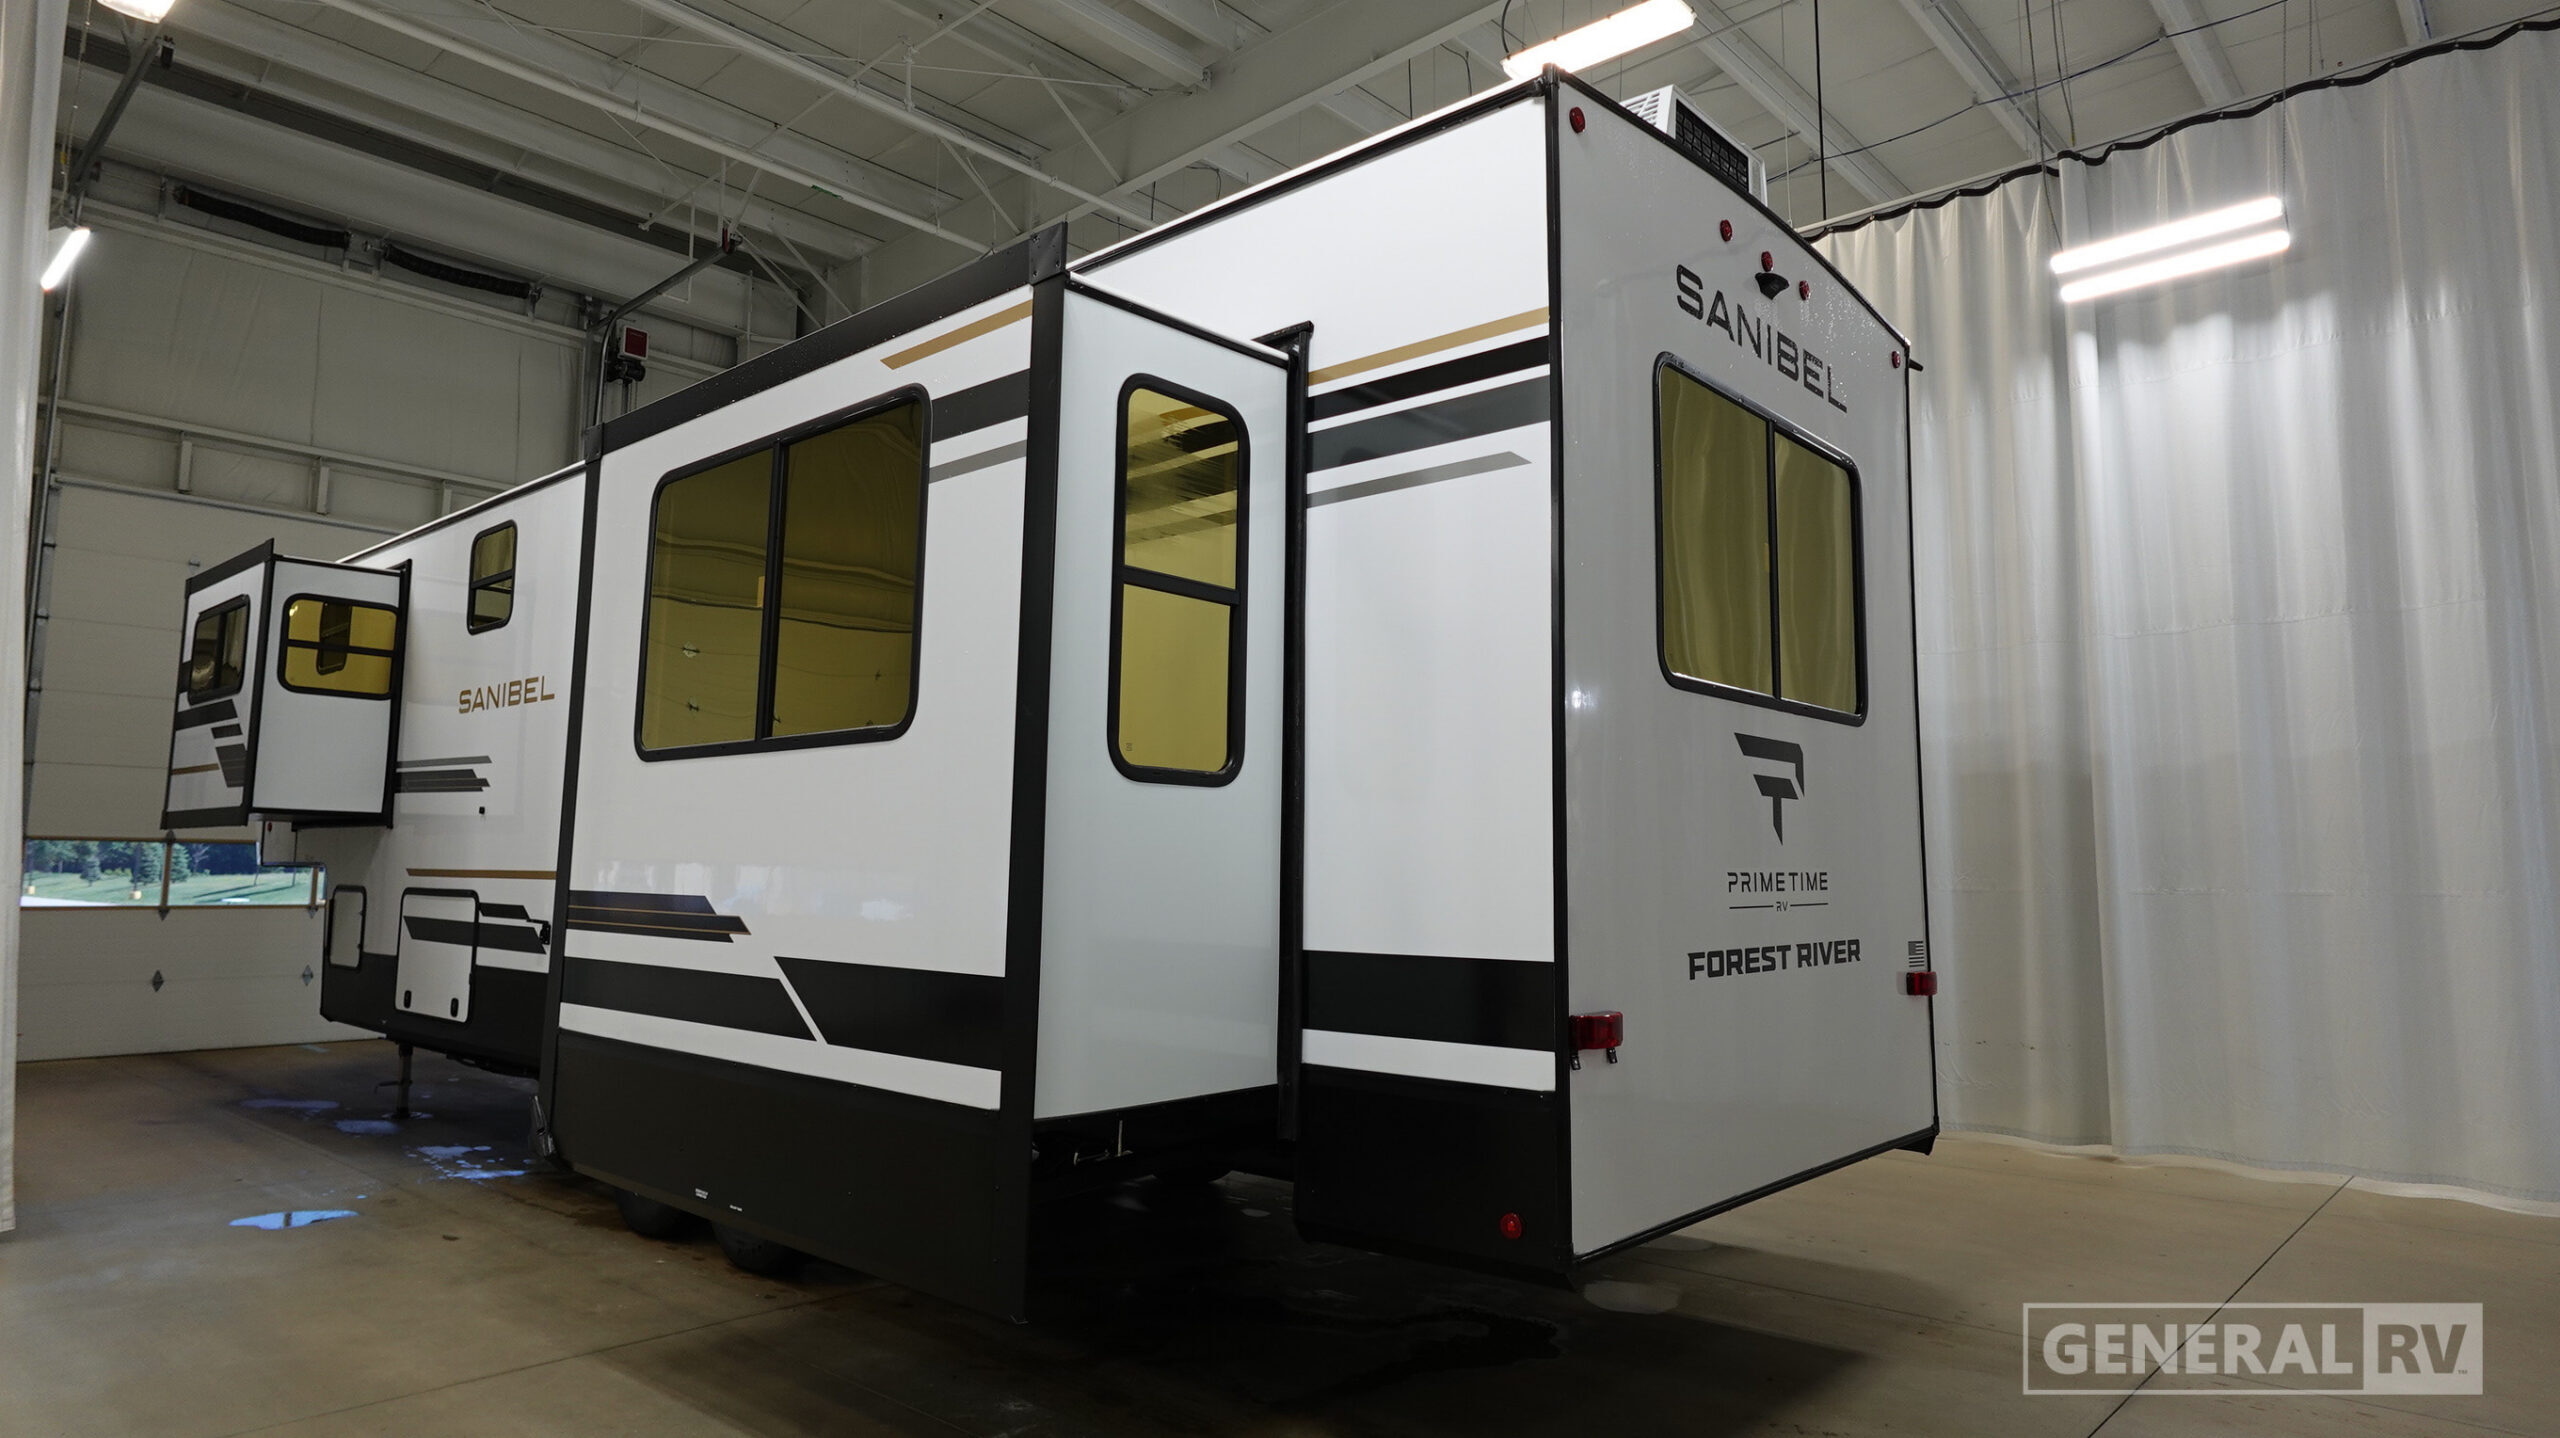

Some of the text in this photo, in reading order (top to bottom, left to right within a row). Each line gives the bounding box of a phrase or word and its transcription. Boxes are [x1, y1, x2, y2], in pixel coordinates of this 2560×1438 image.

[1676, 264, 1848, 414] SANIBEL
[458, 675, 556, 714] SANIBEL
[1775, 901, 1789, 912] RV
[1687, 938, 1861, 981] FOREST RIVER
